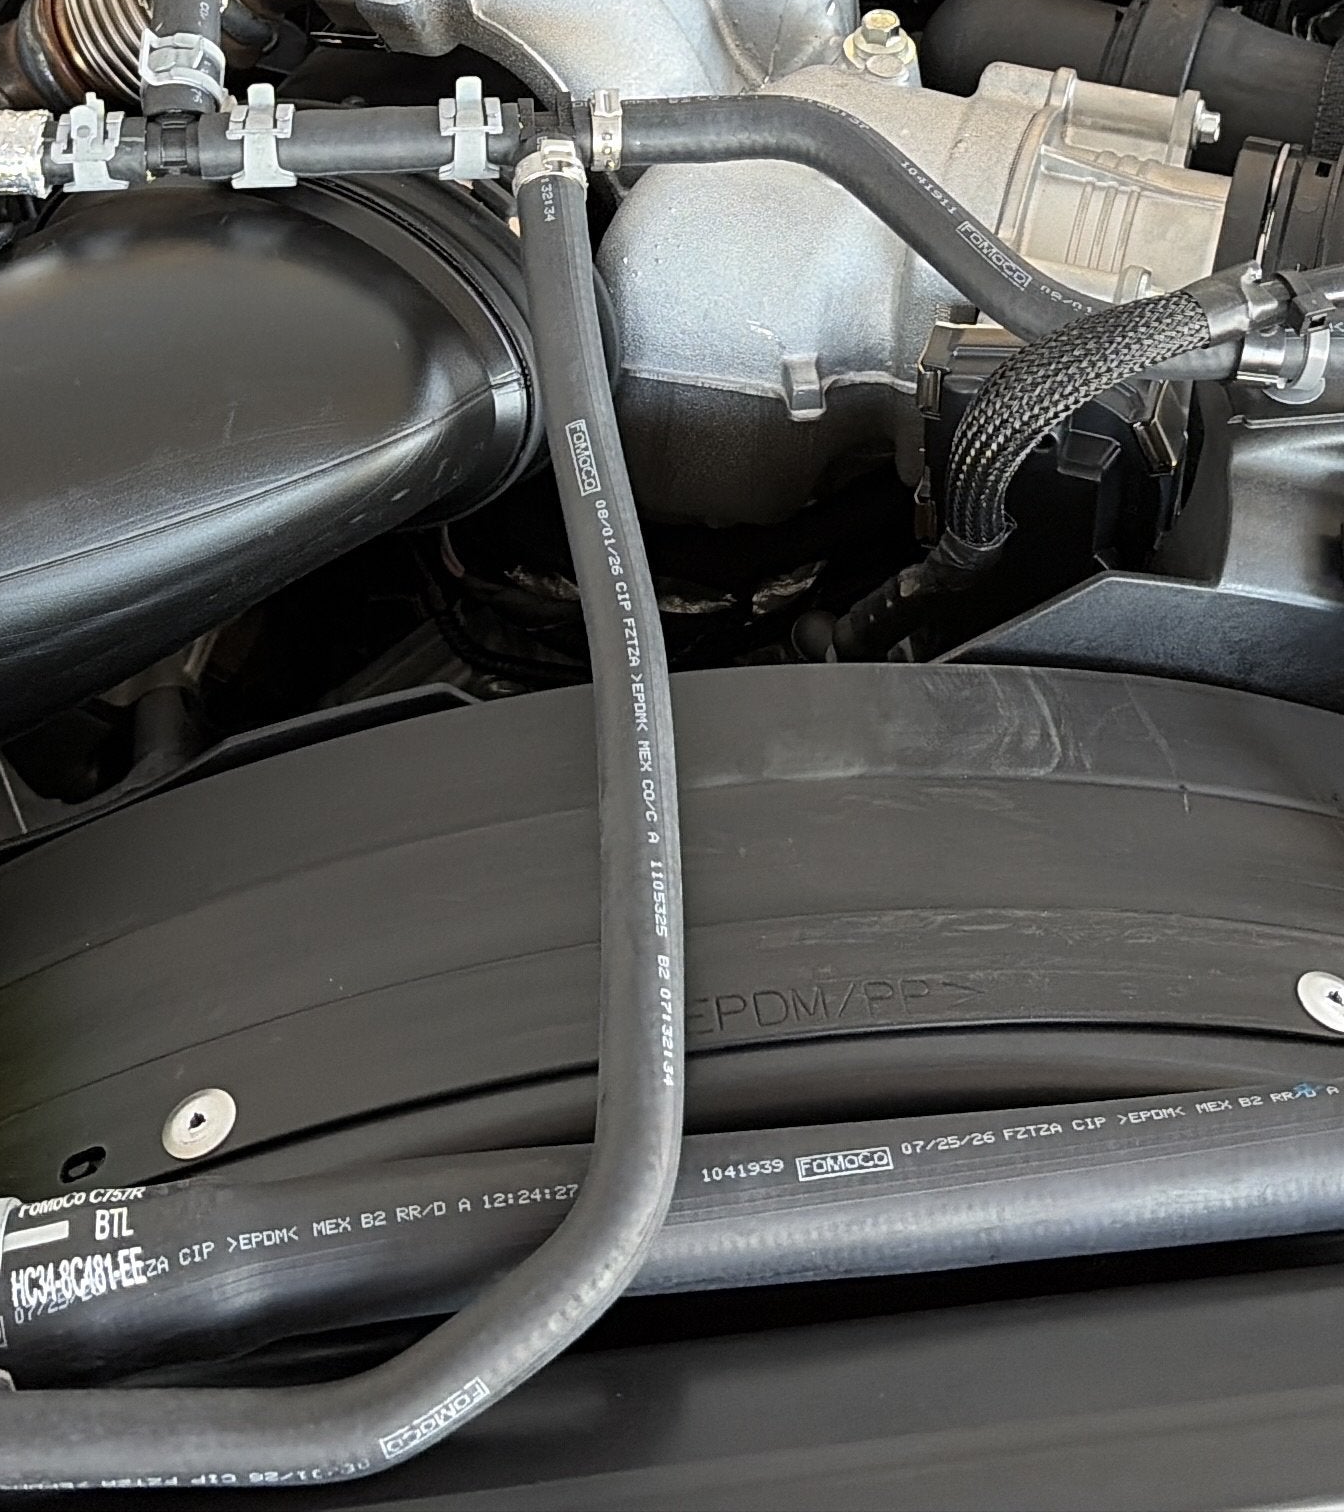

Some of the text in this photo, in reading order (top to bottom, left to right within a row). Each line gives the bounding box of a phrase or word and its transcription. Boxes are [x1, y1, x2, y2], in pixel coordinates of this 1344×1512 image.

[958, 222, 1032, 288] FoMoCo
[567, 421, 600, 493] FoMoCo
[594, 498, 624, 577] 08/01/26
[615, 580, 633, 612] CIP
[630, 672, 649, 733] >EPDM<
[637, 739, 654, 773] MEX
[641, 778, 658, 823] CO/C
[647, 830, 661, 845] A
[649, 859, 669, 939] 1105325
[657, 954, 670, 980] B2
[701, 1157, 785, 1183] 1041939
[799, 1150, 891, 1178] FoMoCo
[900, 1130, 995, 1156] 07/25/26
[1002, 1122, 1064, 1142] FZTZA
[1071, 1116, 1107, 1132] CIP
[1117, 1106, 1186, 1126] >EPDM<
[1195, 1099, 1233, 1115] MEX
[1237, 1095, 1264, 1108] B2
[1326, 1085, 1340, 1097] A
[95, 1206, 135, 1241] BTL
[178, 1240, 215, 1268] CIP
[227, 1227, 300, 1255] >EPDM<
[312, 1216, 353, 1239] MEX
[360, 1210, 387, 1230] B2
[396, 1200, 447, 1224] RR/D
[458, 1197, 472, 1214] A
[482, 1183, 579, 1210] 12:24:27
[383, 1379, 487, 1455] FoMoCo
